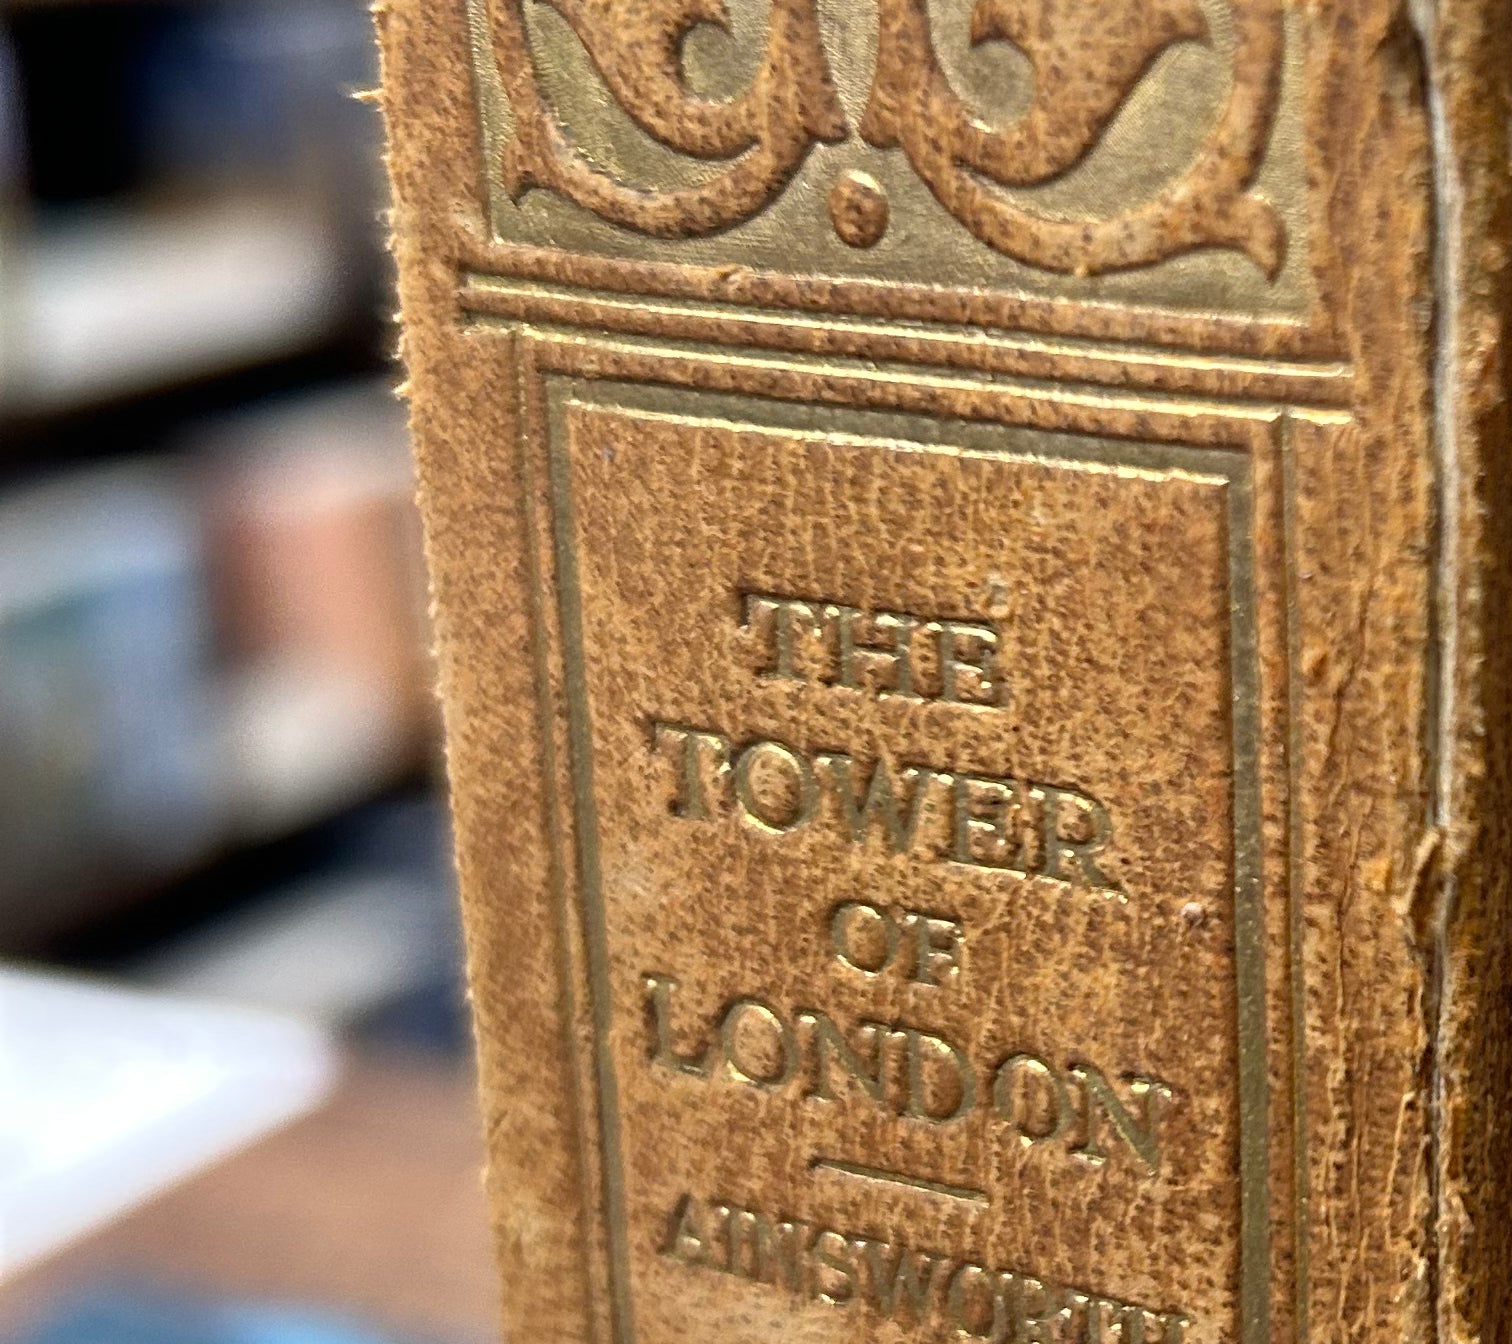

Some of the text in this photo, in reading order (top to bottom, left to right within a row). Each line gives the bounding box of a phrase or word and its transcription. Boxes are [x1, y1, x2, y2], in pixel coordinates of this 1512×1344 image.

[740, 591, 1006, 706] THE
[652, 722, 1128, 903] TOWER
[834, 902, 965, 985] OF
[643, 973, 1174, 1176] LONDON
